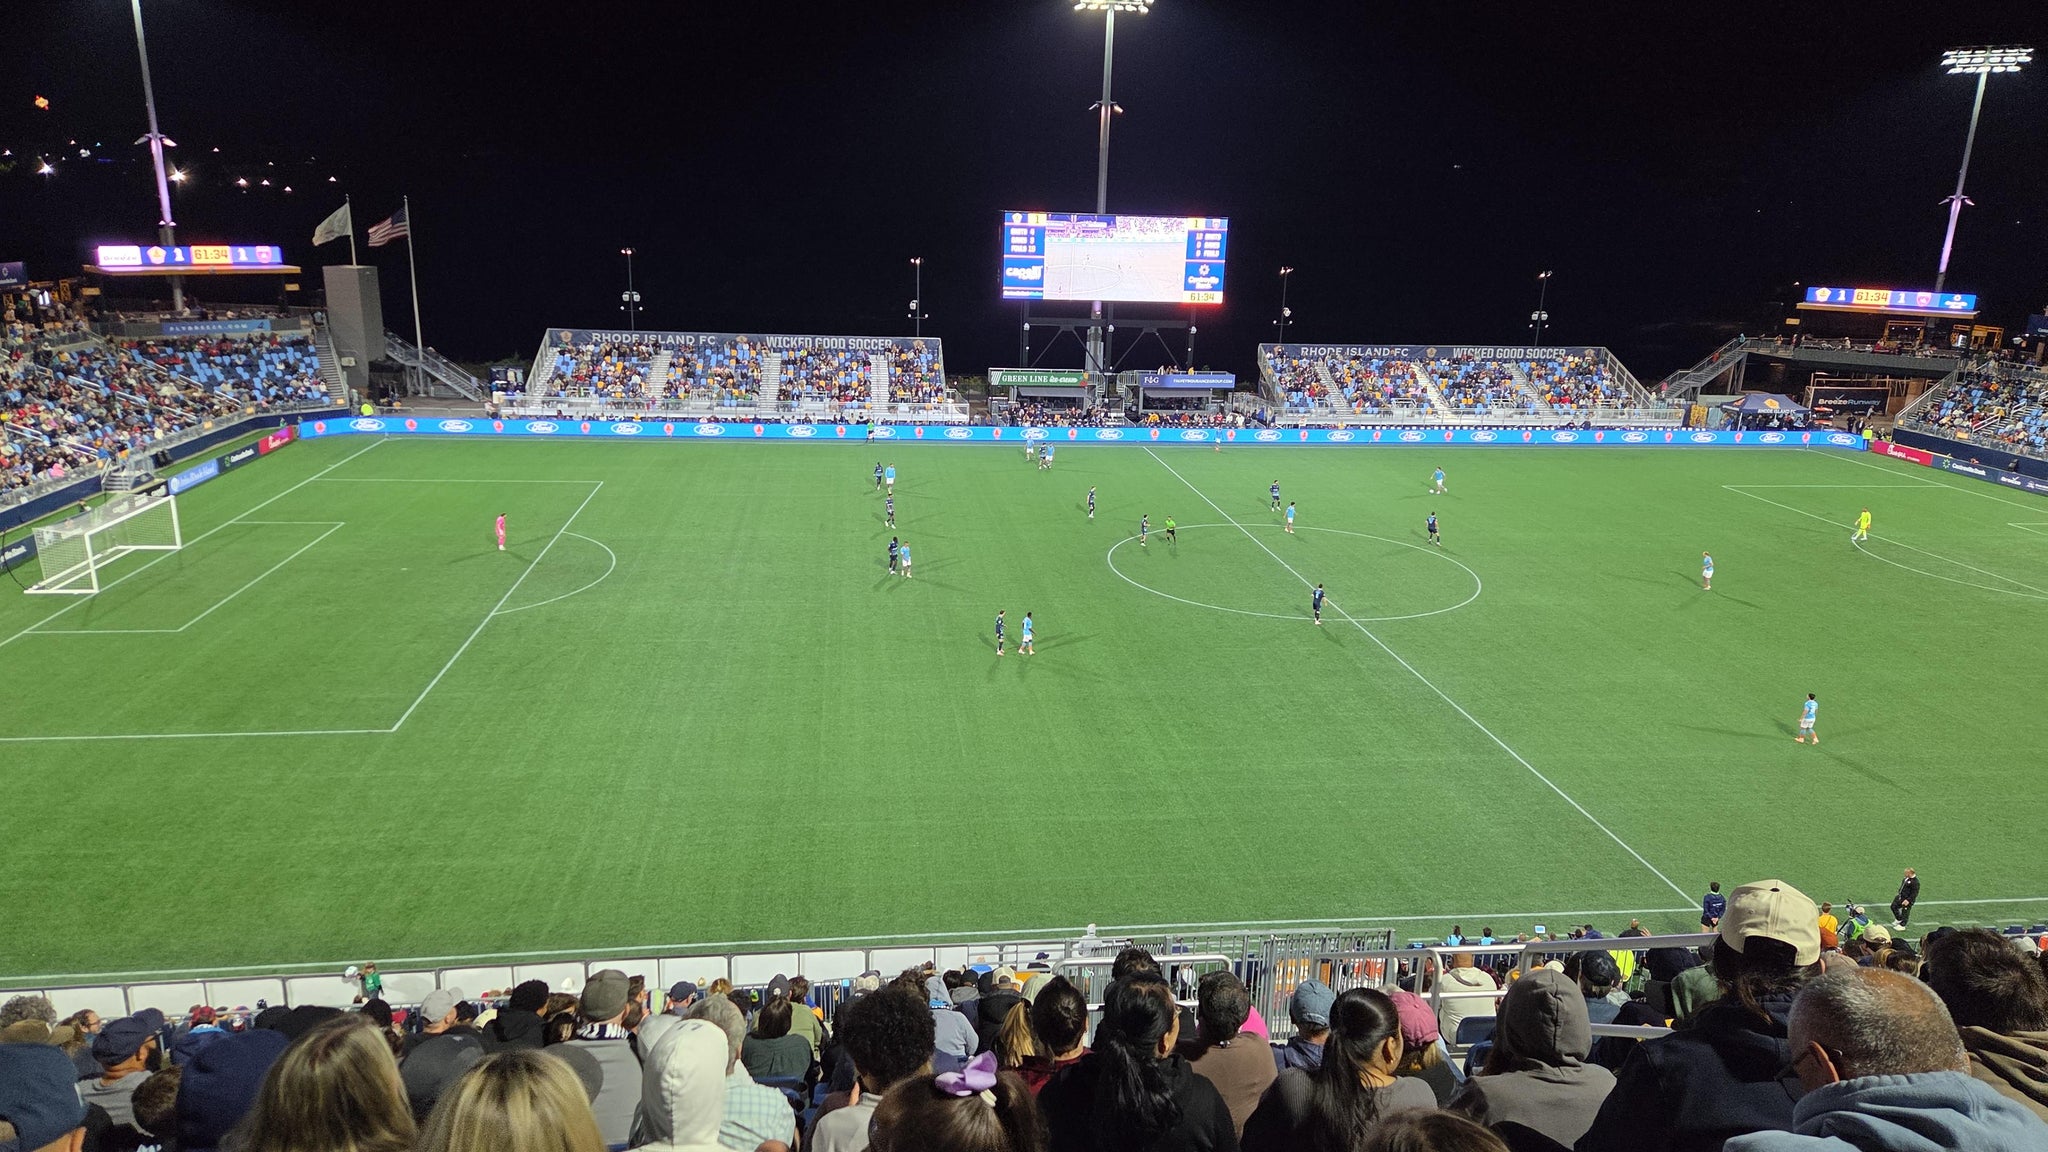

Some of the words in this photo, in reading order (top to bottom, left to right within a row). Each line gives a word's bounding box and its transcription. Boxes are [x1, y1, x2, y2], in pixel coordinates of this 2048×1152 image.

[173, 248, 185, 261] 1
[194, 248, 228, 260] 61:34
[237, 248, 248, 261] 1
[1190, 291, 1215, 302] 61:34
[1836, 289, 1846, 301] 1
[1856, 290, 1888, 302] 61:34
[1899, 292, 1906, 304] 1
[591, 332, 641, 343] RHODE
[644, 334, 695, 345] ISLAND
[700, 335, 716, 345] FC
[766, 336, 813, 348] WICKED
[815, 337, 847, 350] GOOD
[848, 338, 893, 350] SOCCER
[1300, 346, 1343, 356] RHODE
[1346, 347, 1391, 356] ISLAND
[1394, 348, 1409, 356] FC
[1453, 347, 1495, 359] WICKED
[1496, 347, 1524, 359] GOOD
[1526, 348, 1566, 360] SOCCER
[1001, 375, 1026, 383] GREEN
[1029, 375, 1048, 383] LINE
[354, 418, 382, 432] Ford
[442, 420, 470, 432] Ford
[529, 421, 556, 434] Ford
[614, 422, 640, 435] Ford
[697, 423, 722, 436] Ford
[790, 424, 814, 437] Ford
[947, 426, 970, 439] Ford
[1024, 428, 1045, 440] Ford
[1100, 428, 1120, 440] Ford
[1184, 429, 1206, 440] Ford
[1258, 430, 1278, 440] Ford
[1330, 430, 1350, 441] Ford
[1402, 430, 1422, 442] Ford
[1474, 431, 1494, 442] Ford
[1555, 431, 1575, 442] Ford
[1625, 432, 1644, 442] Ford
[1694, 432, 1714, 443] Ford
[1762, 432, 1782, 444] Ford
[1830, 434, 1852, 444] Ford
